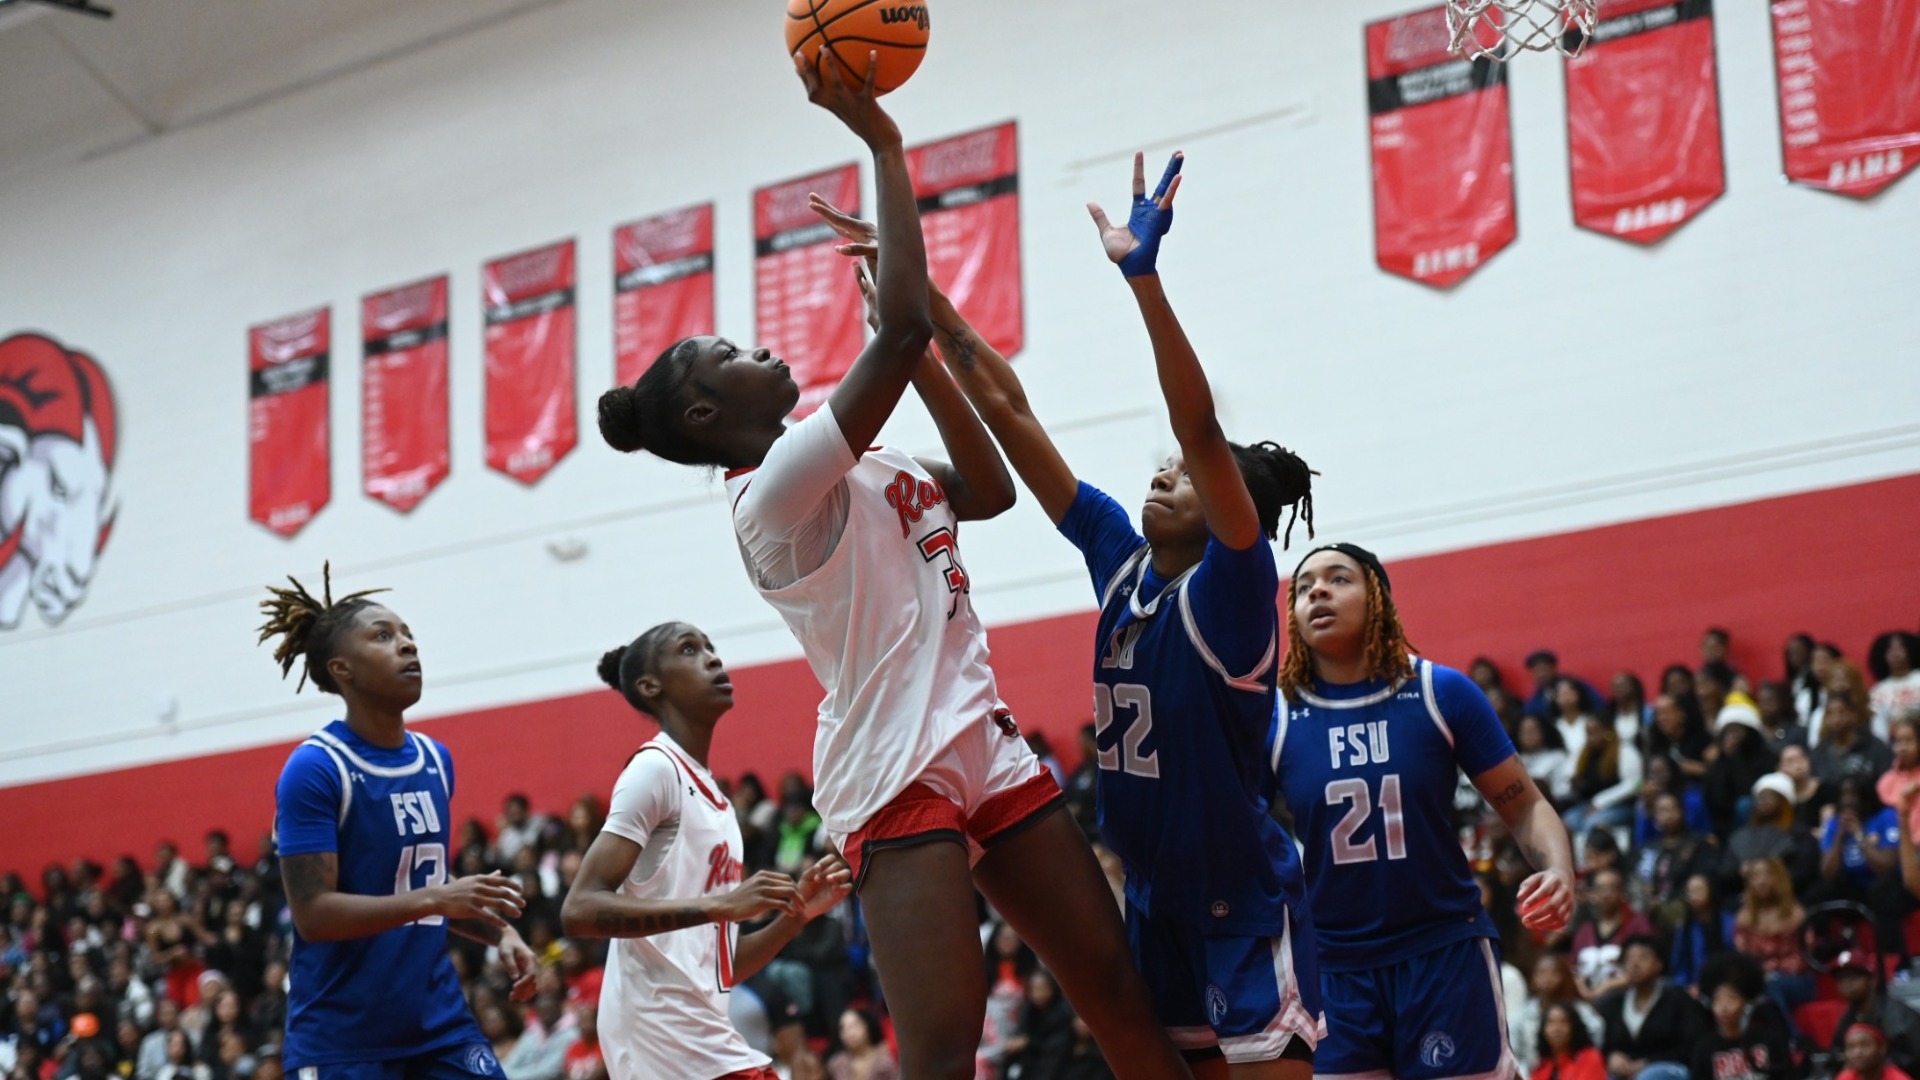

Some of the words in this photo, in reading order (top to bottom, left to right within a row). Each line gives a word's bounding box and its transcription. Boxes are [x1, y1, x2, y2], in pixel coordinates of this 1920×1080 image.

[1828, 149, 1903, 188] RAMS
[1614, 196, 1687, 234] RAMS
[884, 469, 947, 540] Ra
[916, 521, 970, 621] 3
[1101, 622, 1147, 670] SU
[1093, 683, 1160, 779] 22
[1328, 721, 1390, 769] FSU
[389, 790, 441, 837] FSU
[1325, 774, 1408, 865] 21
